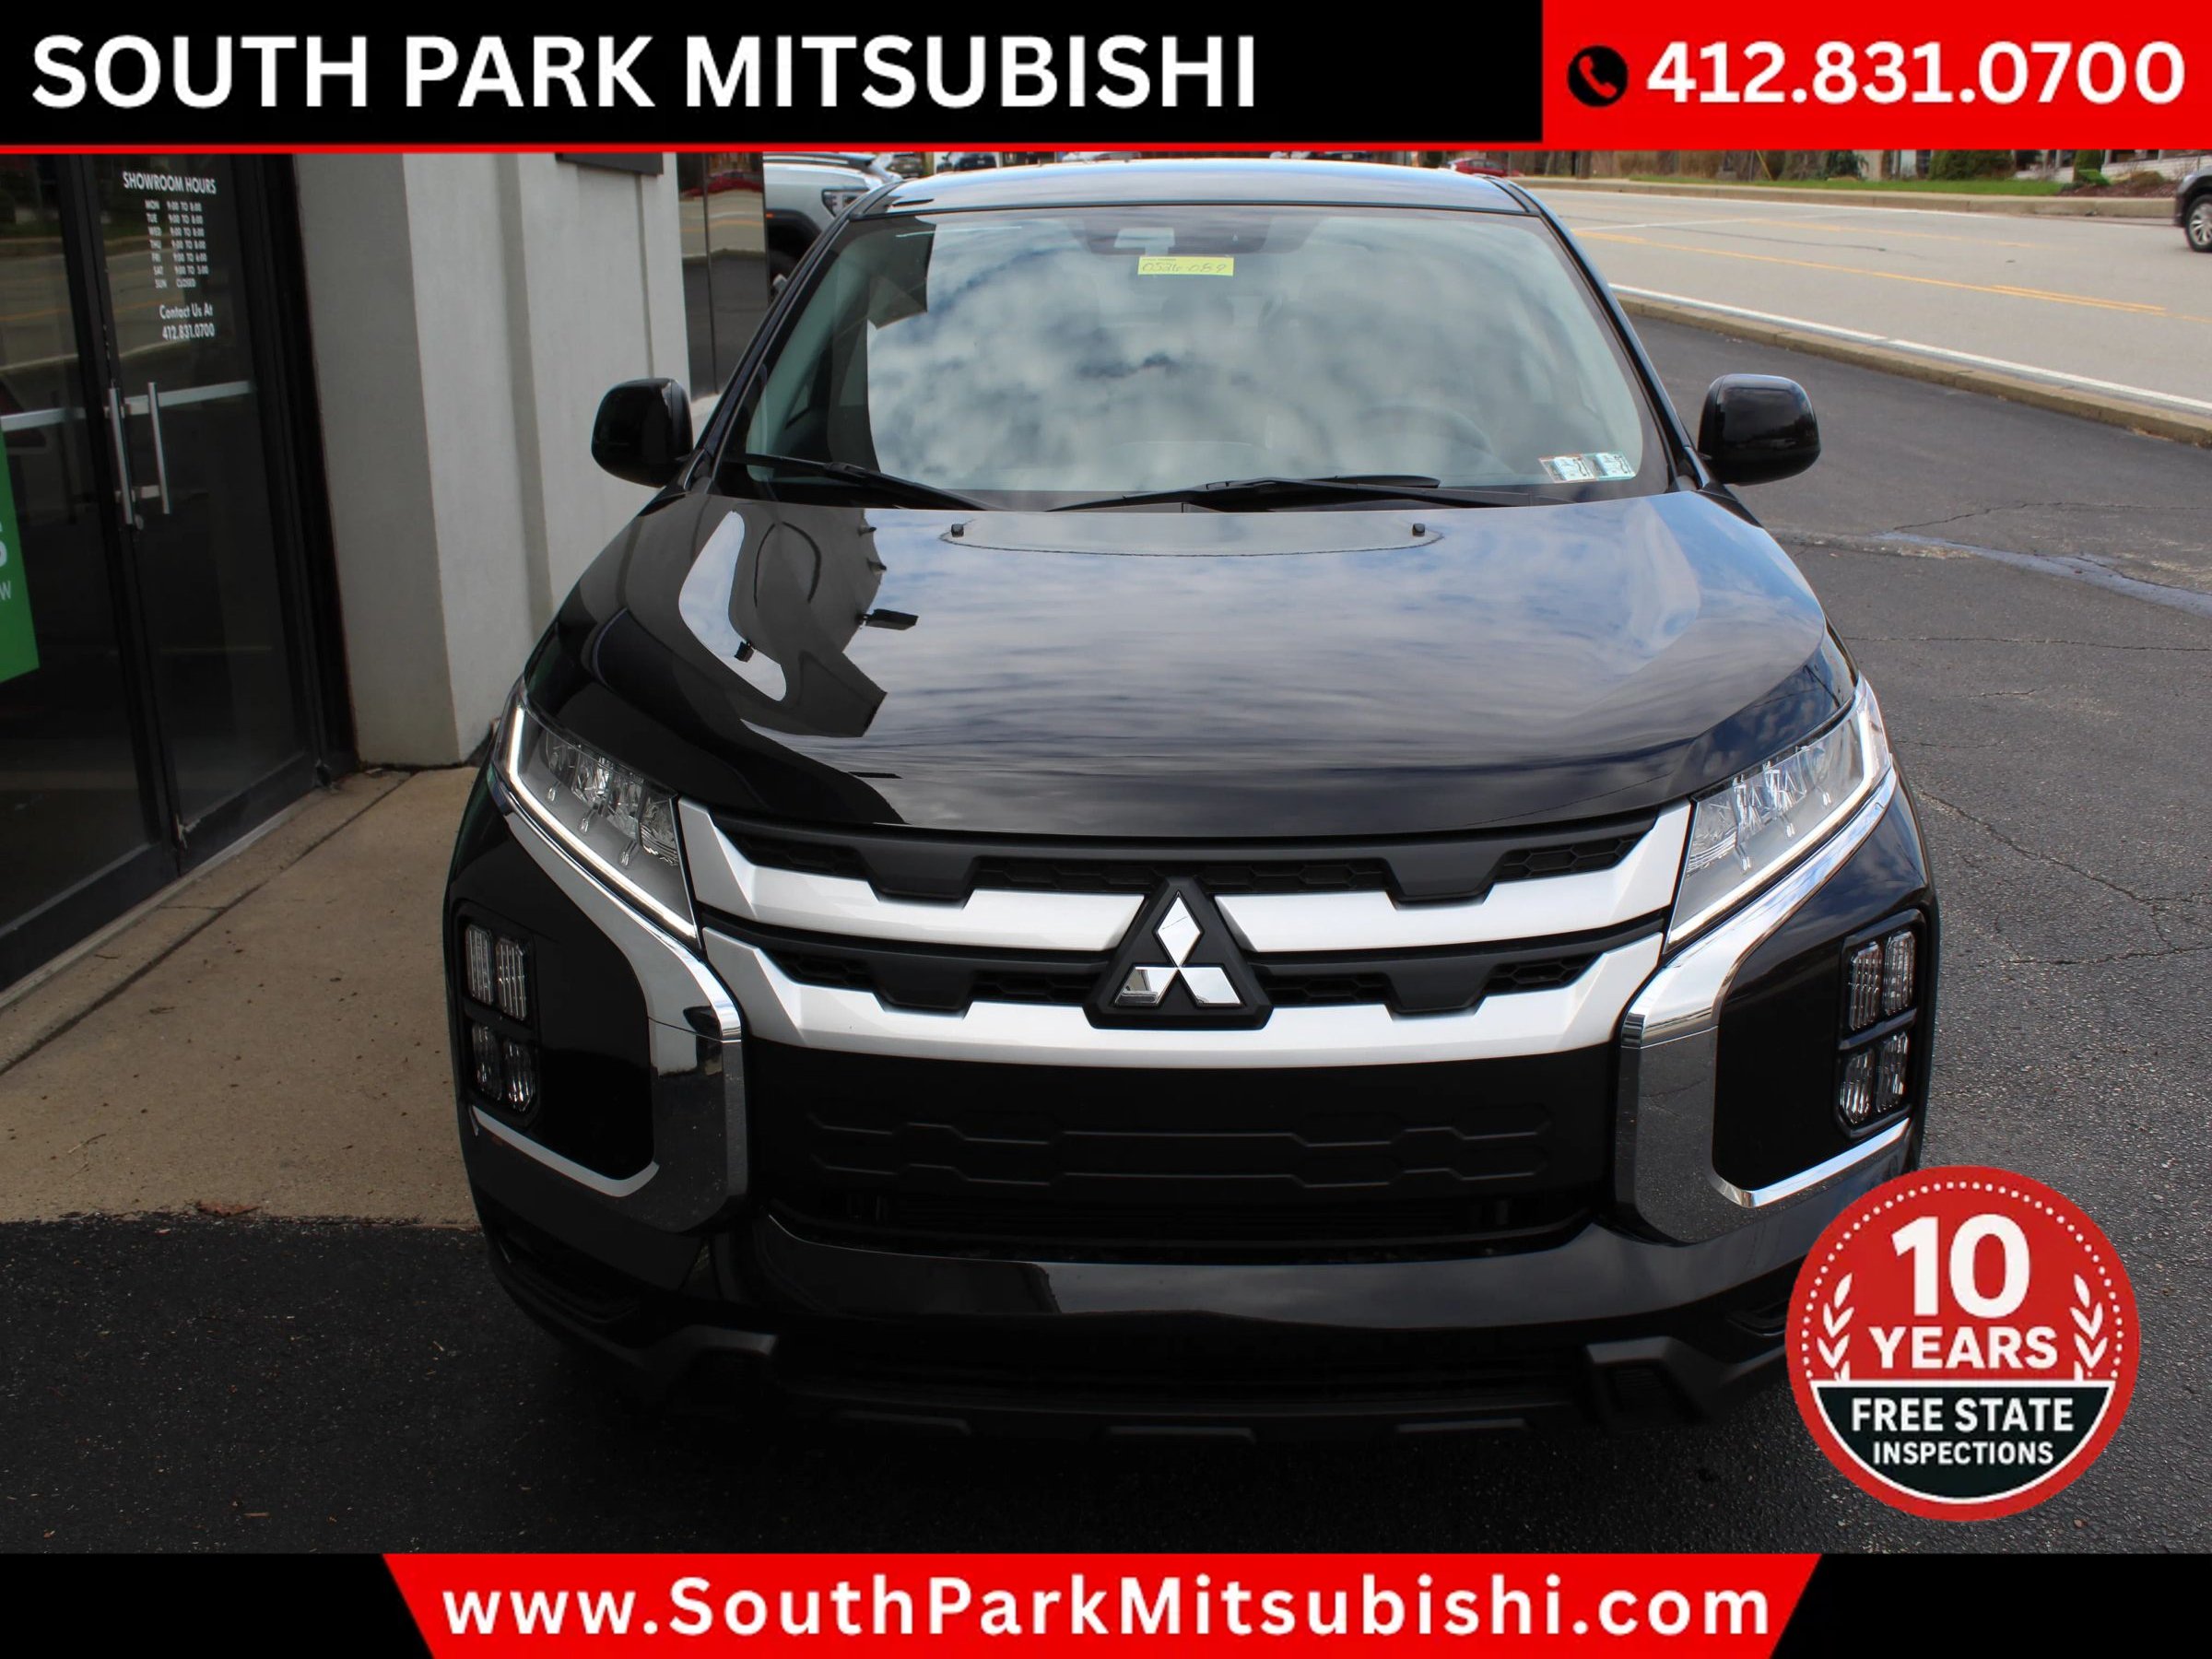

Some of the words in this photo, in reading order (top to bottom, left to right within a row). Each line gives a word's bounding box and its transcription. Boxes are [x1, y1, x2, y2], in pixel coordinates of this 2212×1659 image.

[123, 171, 184, 192] SHOWROOM
[184, 177, 217, 194] HOURS
[145, 200, 160, 210] MON
[180, 202, 189, 212] TO
[146, 213, 158, 223] TUE
[181, 214, 190, 224] TO
[147, 227, 162, 237] WED
[182, 228, 192, 238] TO
[149, 240, 161, 250] THU
[184, 240, 194, 250] TO
[151, 253, 161, 263] FRI
[186, 253, 194, 263] TO
[153, 265, 163, 276] SAT
[187, 265, 195, 276] TO
[176, 278, 196, 288] CLOSED
[159, 304, 190, 320] Contact
[191, 302, 202, 317] Us
[204, 301, 213, 316] At
[161, 323, 215, 341] 412.831.0700
